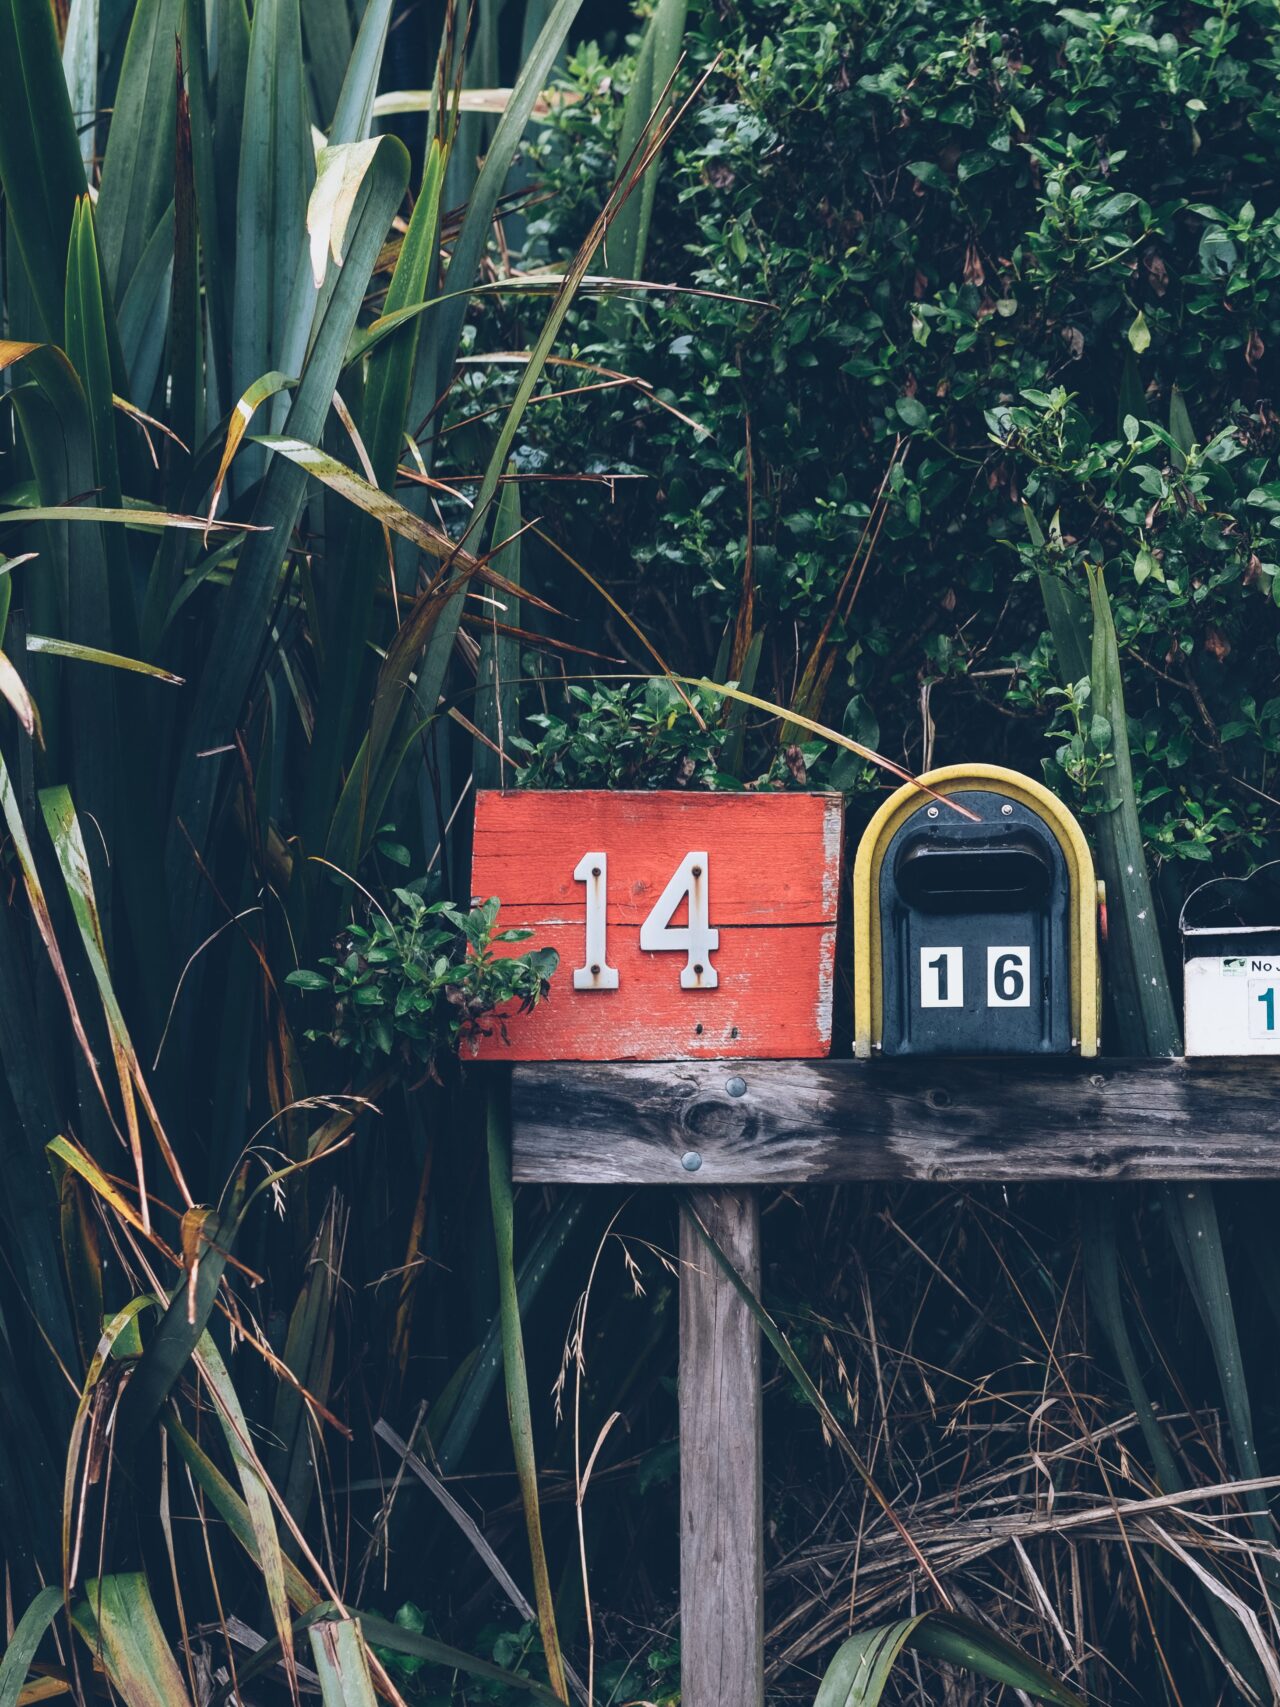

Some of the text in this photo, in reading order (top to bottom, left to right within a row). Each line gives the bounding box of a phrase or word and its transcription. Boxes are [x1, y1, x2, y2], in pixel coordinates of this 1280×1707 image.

[573, 852, 719, 990] 14
[928, 953, 1024, 1001] 16
[1251, 960, 1272, 972] No
